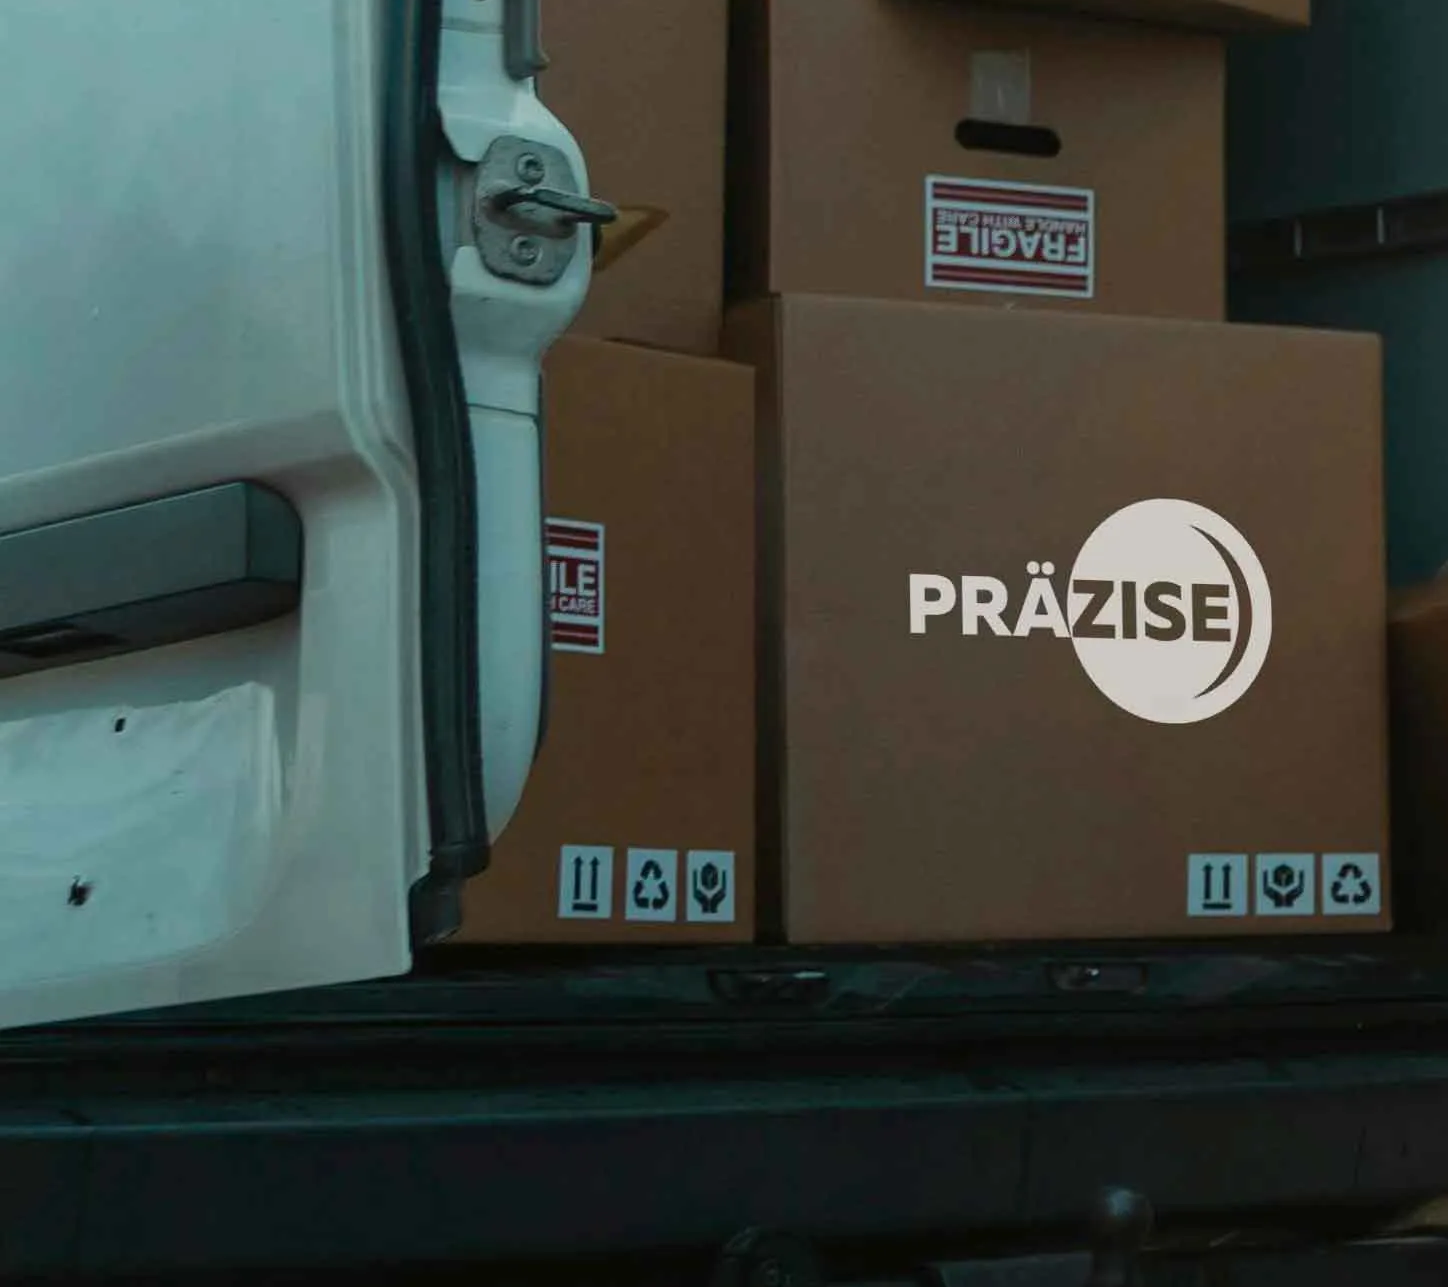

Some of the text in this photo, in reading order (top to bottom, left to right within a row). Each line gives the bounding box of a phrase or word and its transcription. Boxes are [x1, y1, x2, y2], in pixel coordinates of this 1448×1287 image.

[936, 224, 1086, 262] FRAGILE
[559, 596, 596, 614] CARE
[909, 560, 1232, 643] PRÄZISE
